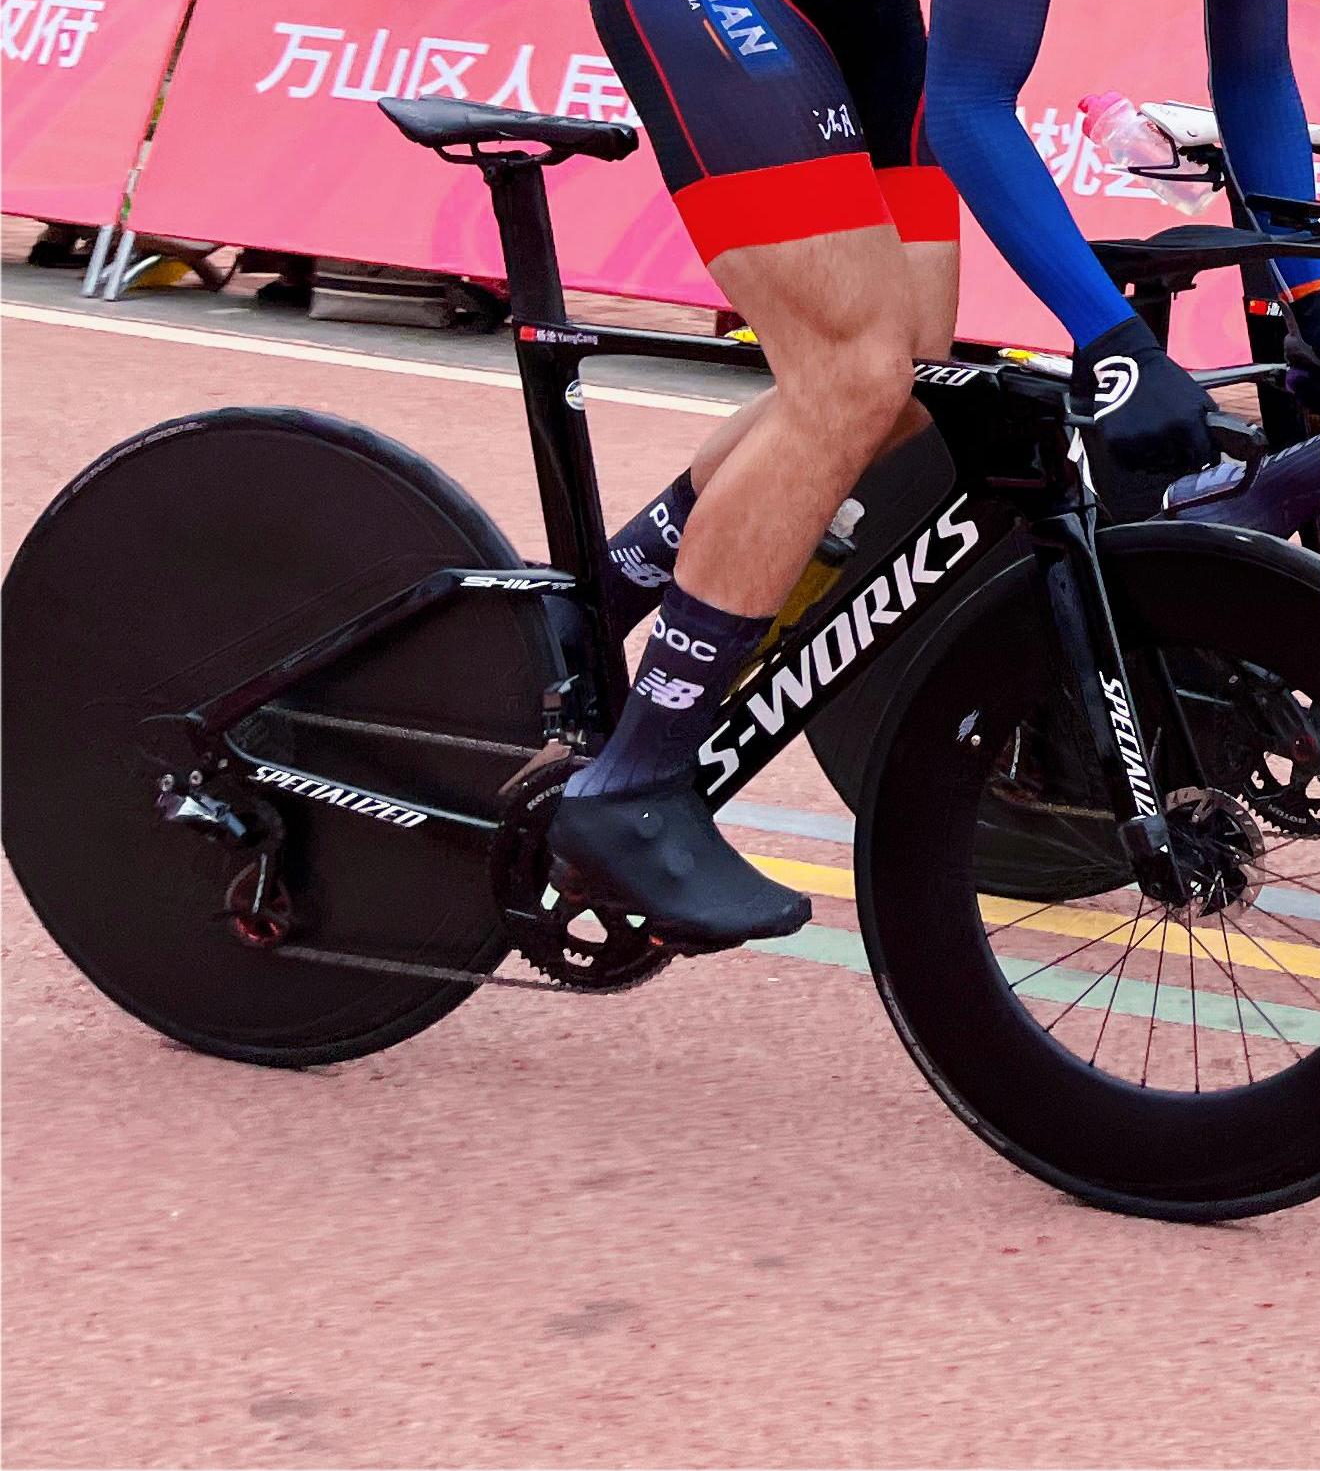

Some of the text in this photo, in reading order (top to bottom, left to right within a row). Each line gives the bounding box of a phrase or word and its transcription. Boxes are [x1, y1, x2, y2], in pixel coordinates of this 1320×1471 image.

[460, 575, 552, 591] SHIV
[698, 492, 980, 796] S-WORKS
[248, 765, 428, 828] SPECIALIZED
[1098, 670, 1158, 821] SPECIALIZ
